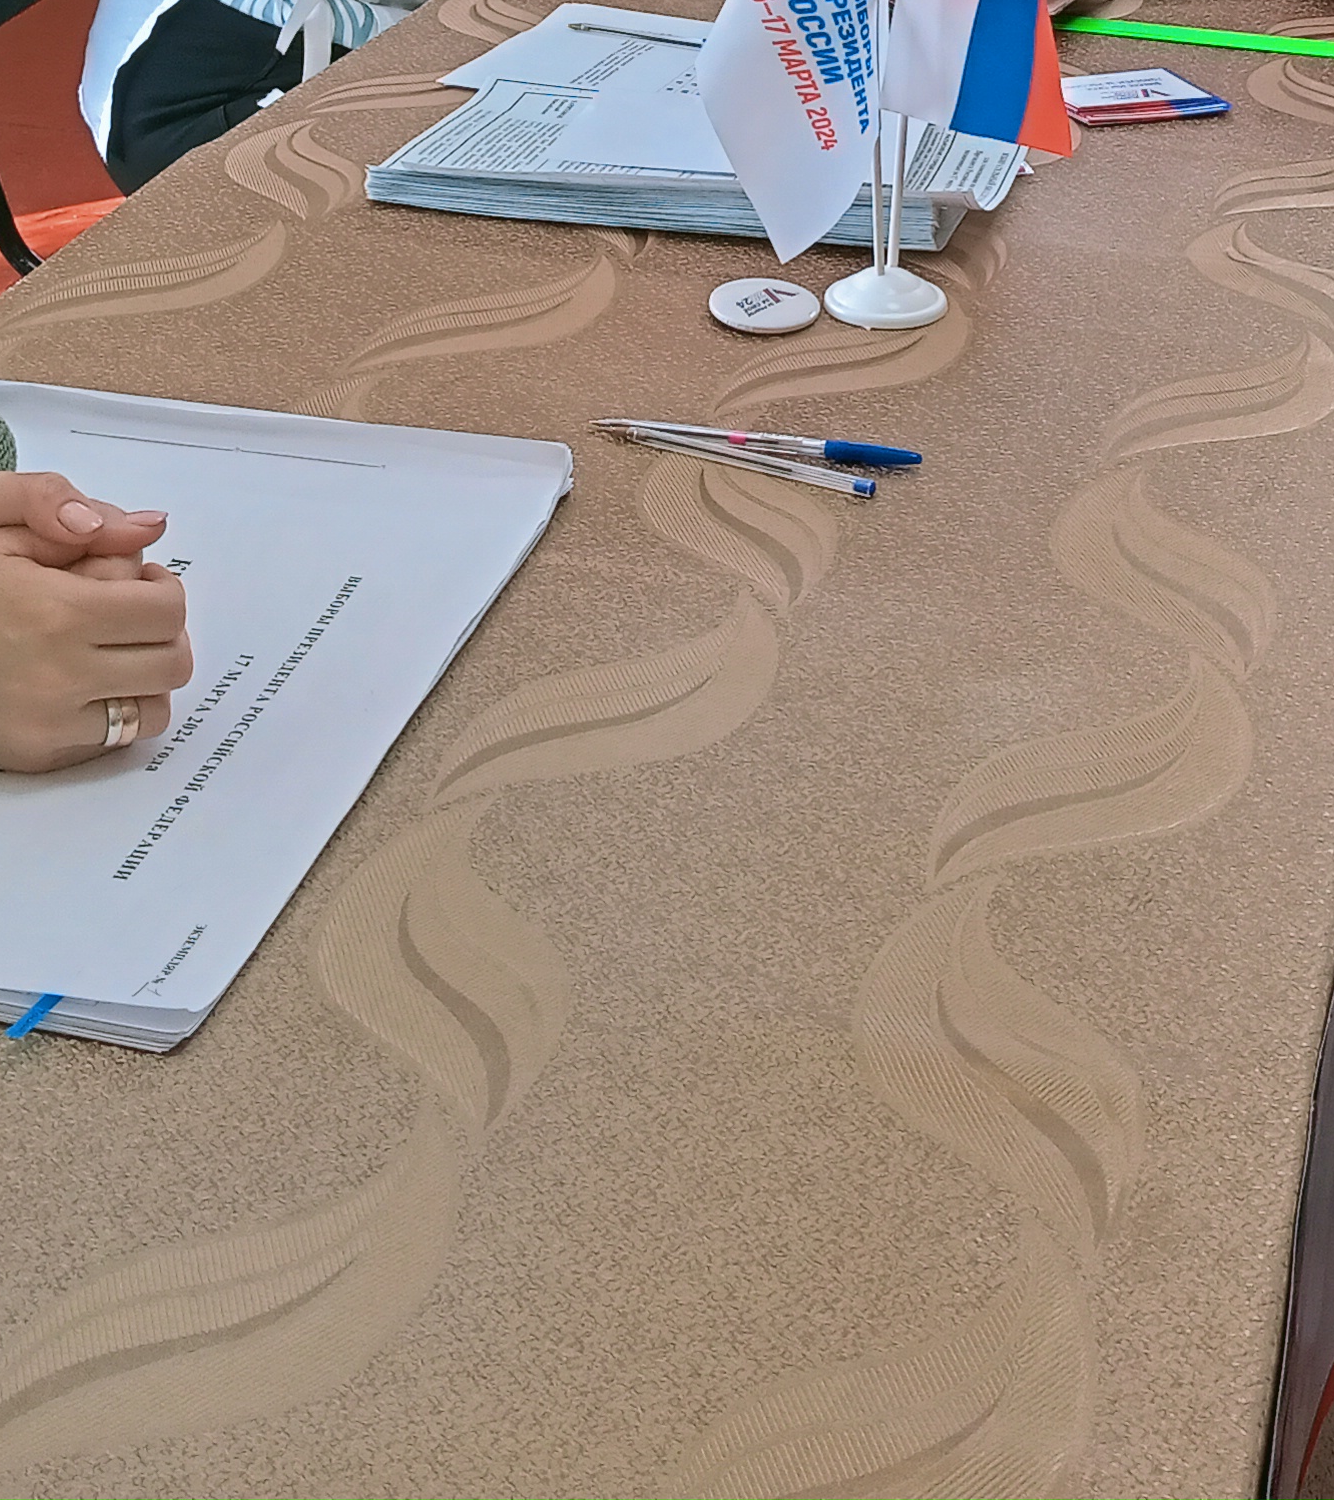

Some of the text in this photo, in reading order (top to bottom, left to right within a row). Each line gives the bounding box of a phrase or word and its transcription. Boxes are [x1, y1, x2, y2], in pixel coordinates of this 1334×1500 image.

[772, 39, 818, 104] МАРТА
[806, 106, 838, 151] 2024
[113, 576, 362, 879] ВЫБОРЫ ПРЕЗИДЕНТА РОССИЙСКОЙ ФЕДЕРАЦИИ
[145, 654, 254, 771] 17 МАРТА 2024 года
